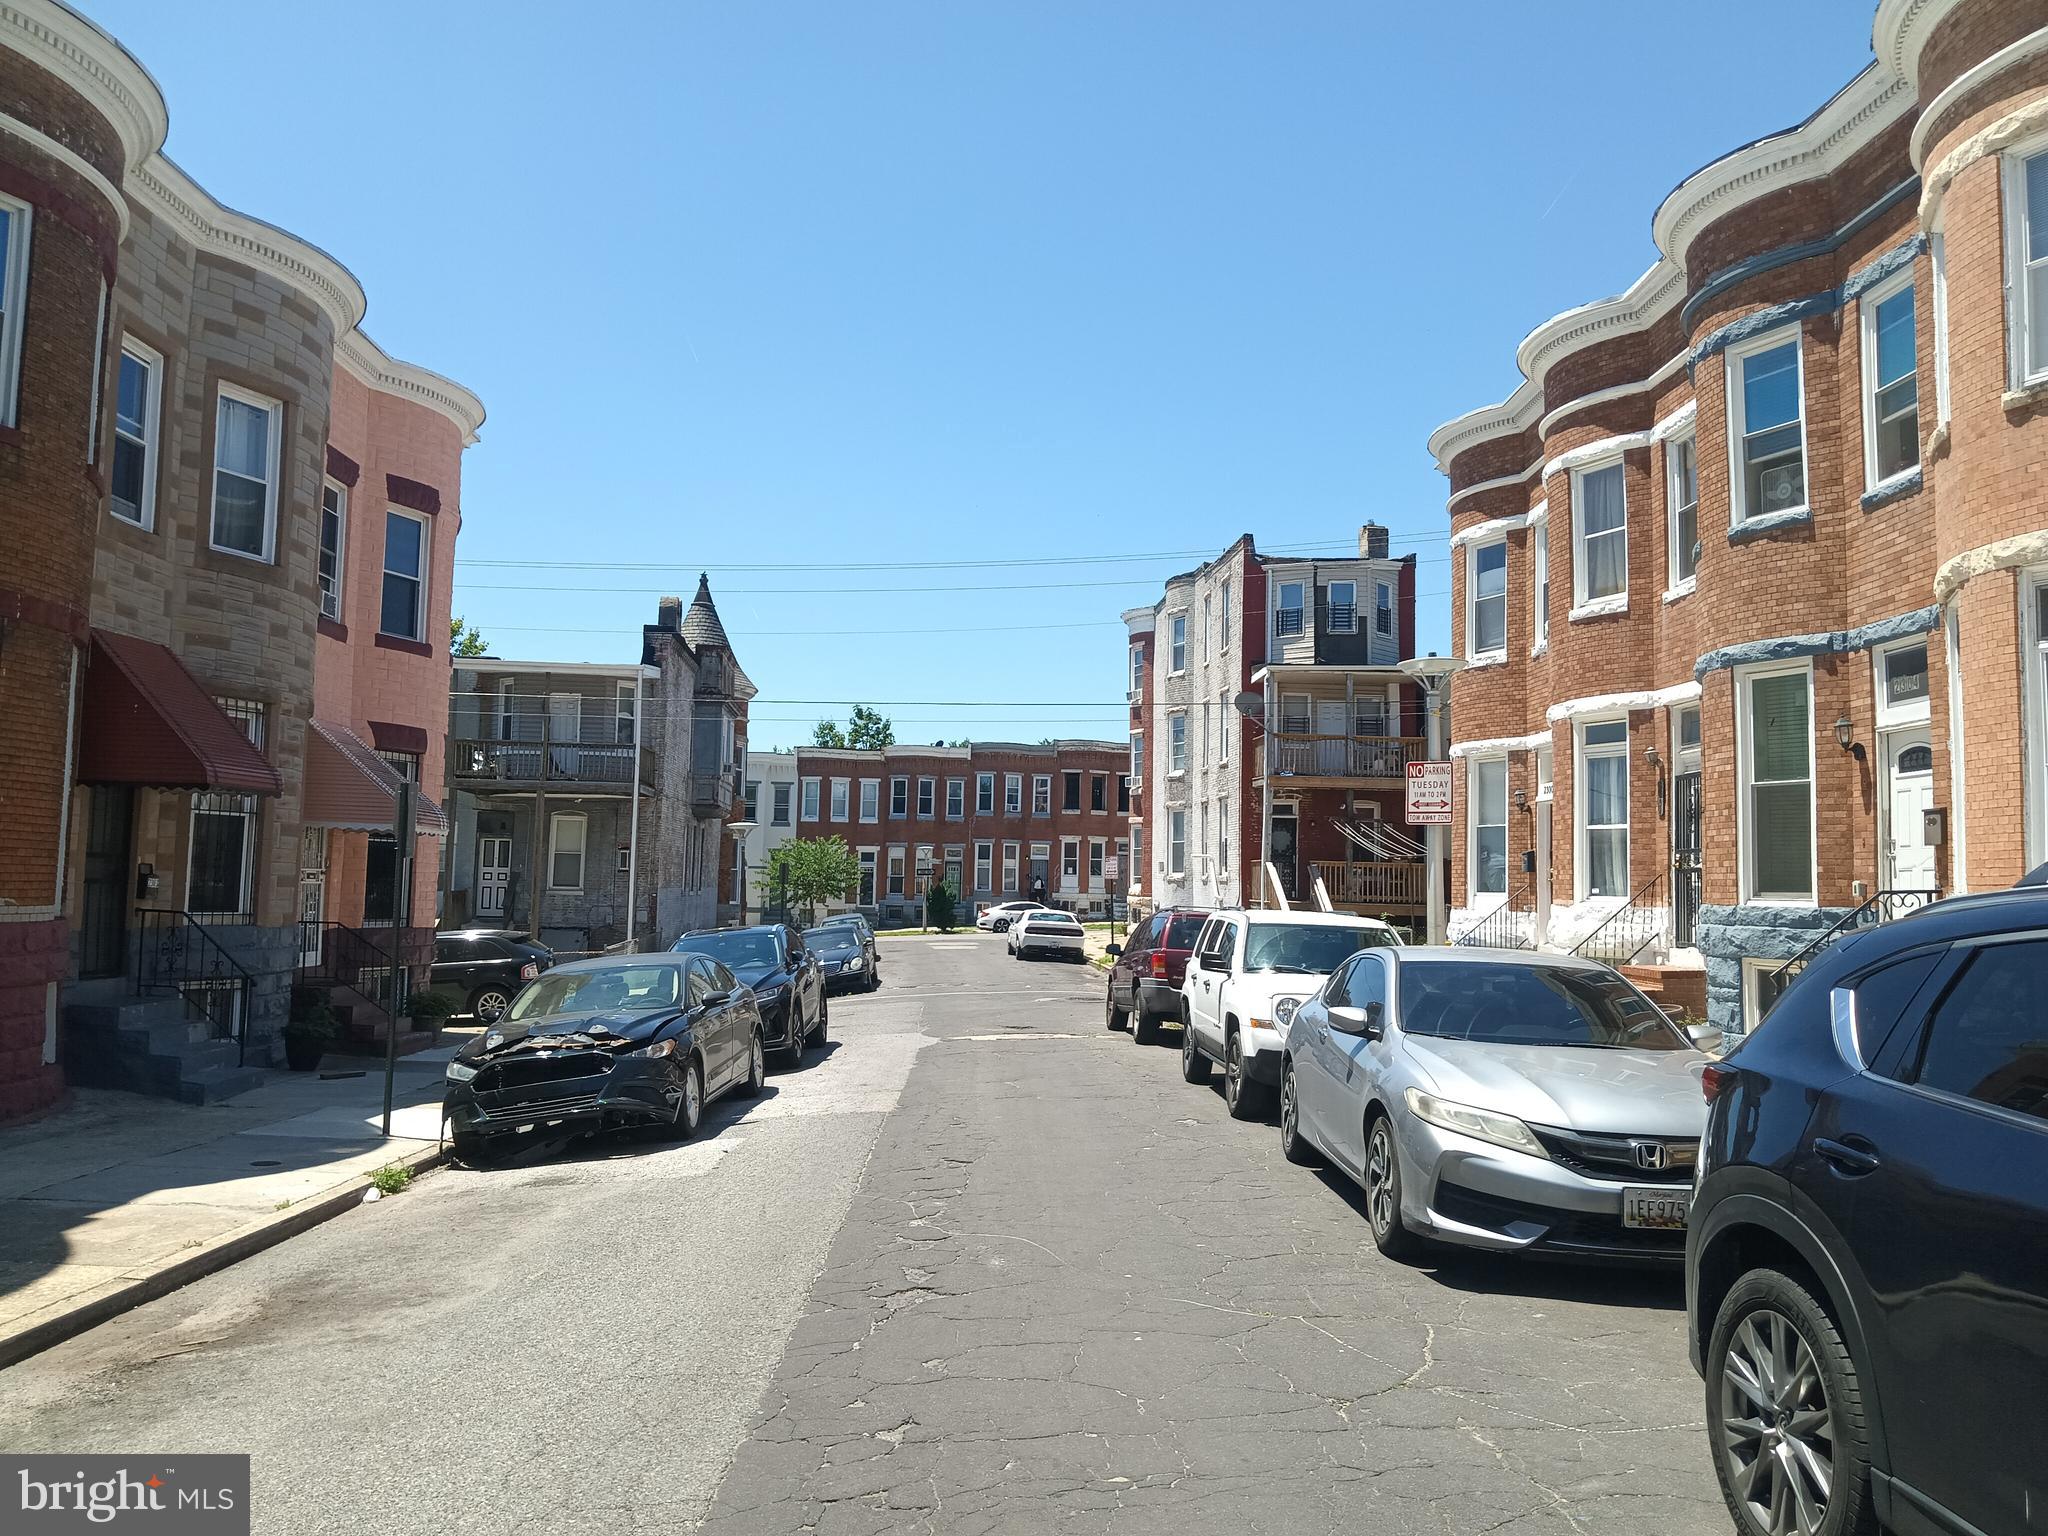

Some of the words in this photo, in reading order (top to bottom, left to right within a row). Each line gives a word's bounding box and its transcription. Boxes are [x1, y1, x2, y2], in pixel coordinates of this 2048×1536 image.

[1893, 673, 1920, 695] 2304
[1409, 766, 1423, 777] NO
[1425, 766, 1450, 776] PARKING
